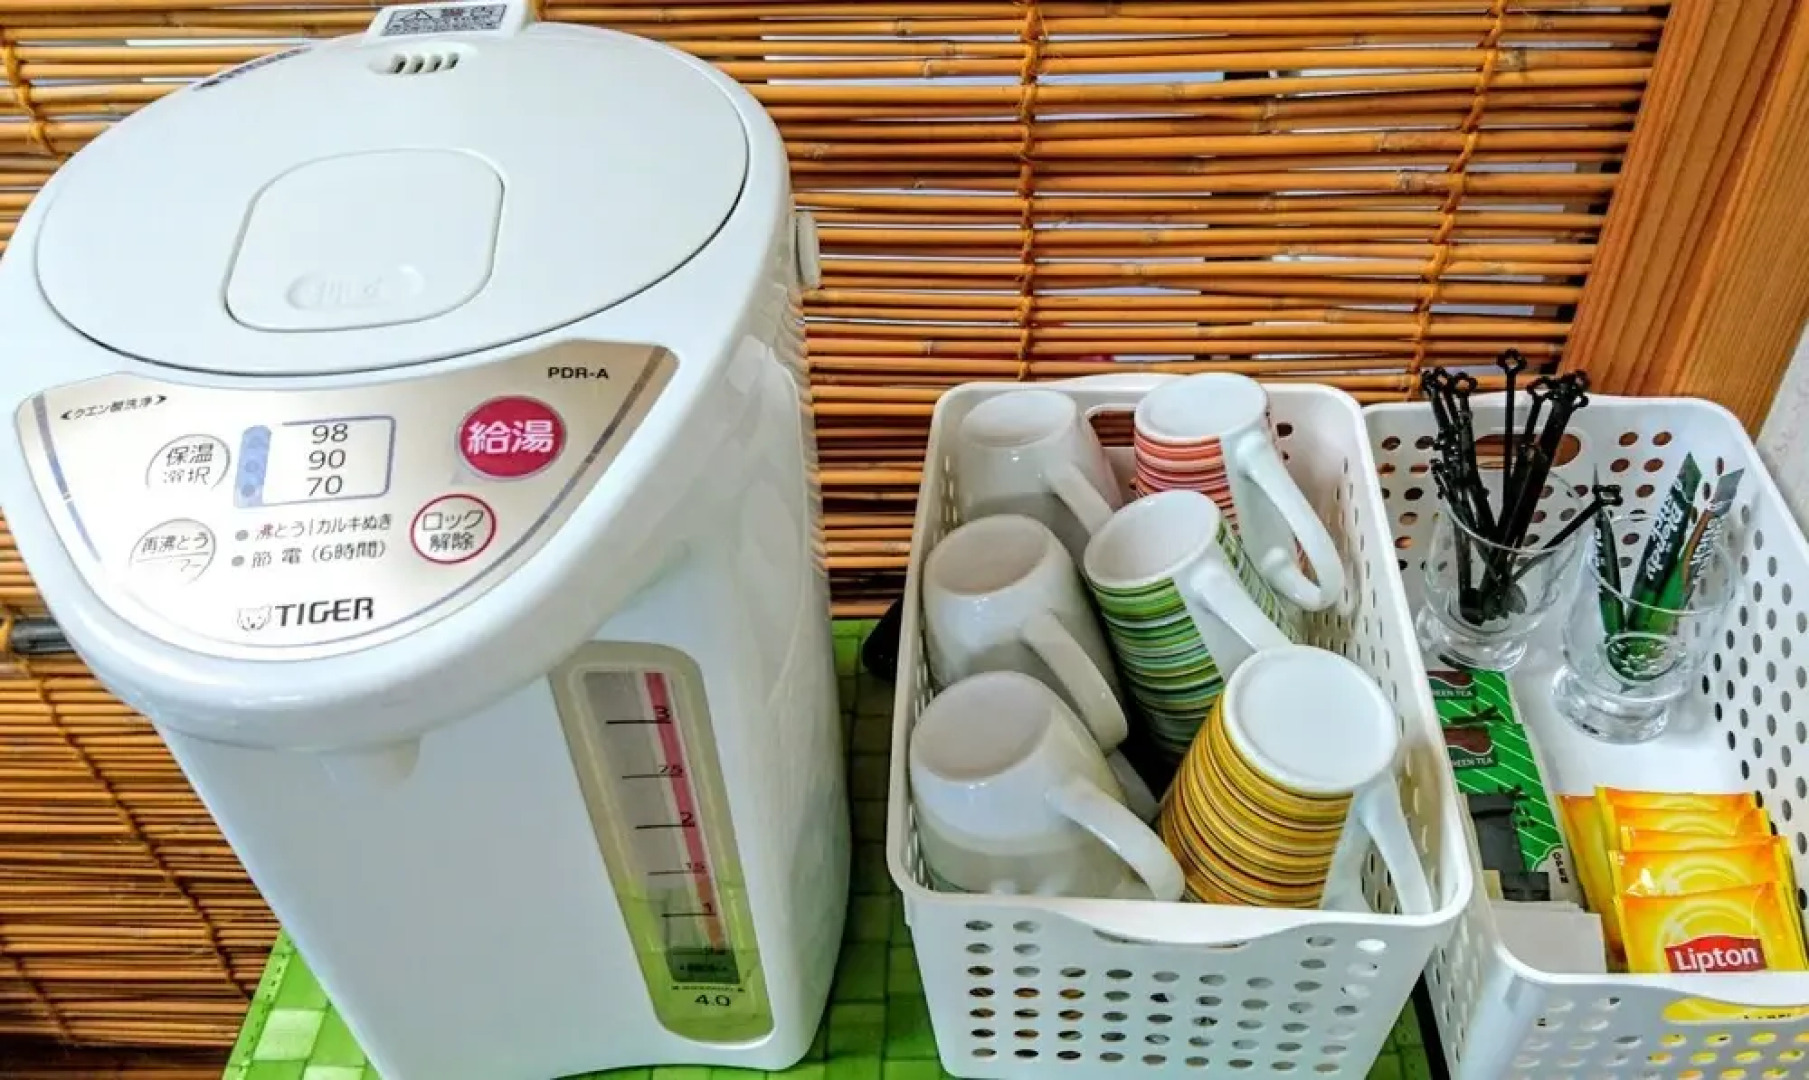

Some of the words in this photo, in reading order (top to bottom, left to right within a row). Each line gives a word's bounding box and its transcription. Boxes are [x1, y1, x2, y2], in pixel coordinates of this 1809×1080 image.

[547, 366, 609, 379] PDR-A
[311, 423, 348, 445] 98
[467, 419, 554, 455] 給湯
[166, 443, 214, 467] 保温
[308, 449, 346, 471] 90
[306, 475, 343, 497] 70
[422, 509, 484, 531] ロック
[430, 532, 475, 552] 解除
[275, 597, 374, 626] TIGER
[680, 811, 696, 827] 2
[1674, 946, 1760, 973] Lipton
